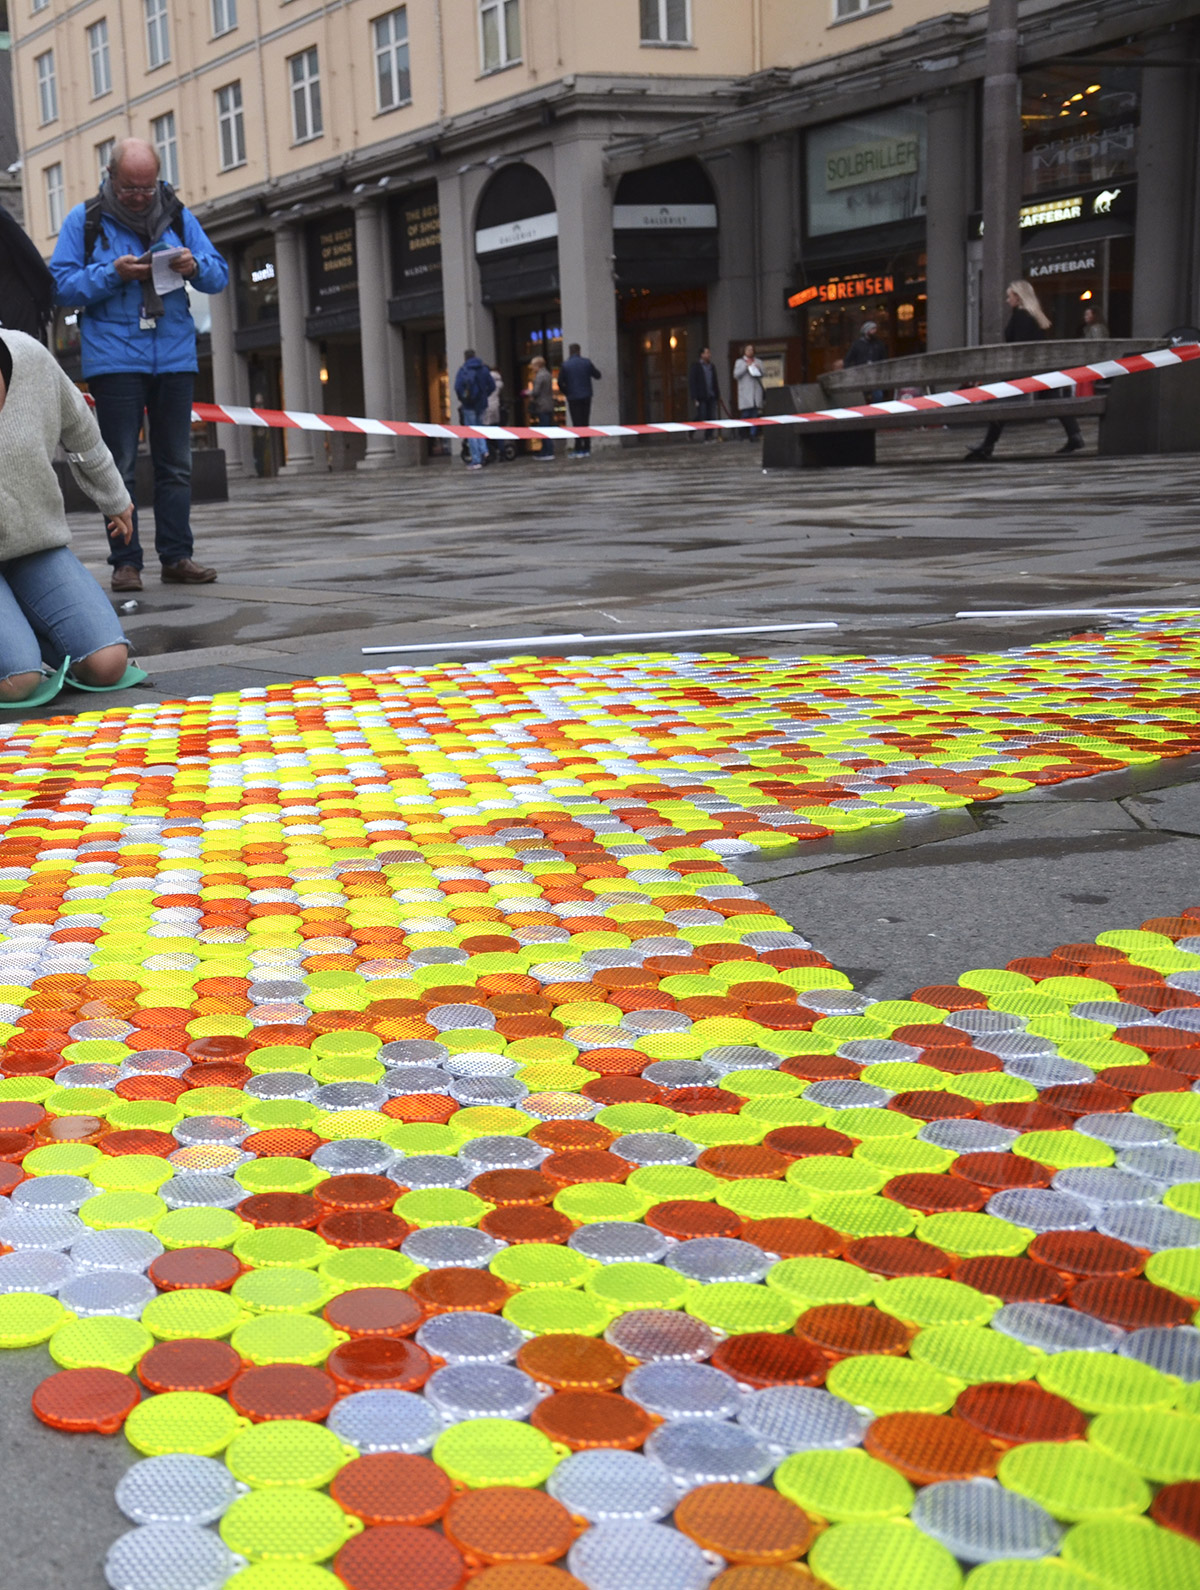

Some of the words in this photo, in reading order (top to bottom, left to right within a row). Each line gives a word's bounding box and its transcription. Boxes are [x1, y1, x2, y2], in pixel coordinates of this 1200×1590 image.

[827, 141, 919, 181] SOLBRILLER
[1023, 199, 1081, 214] ROMEDAR
[407, 224, 418, 237] OF
[1030, 257, 1096, 278] KAFFEBAR
